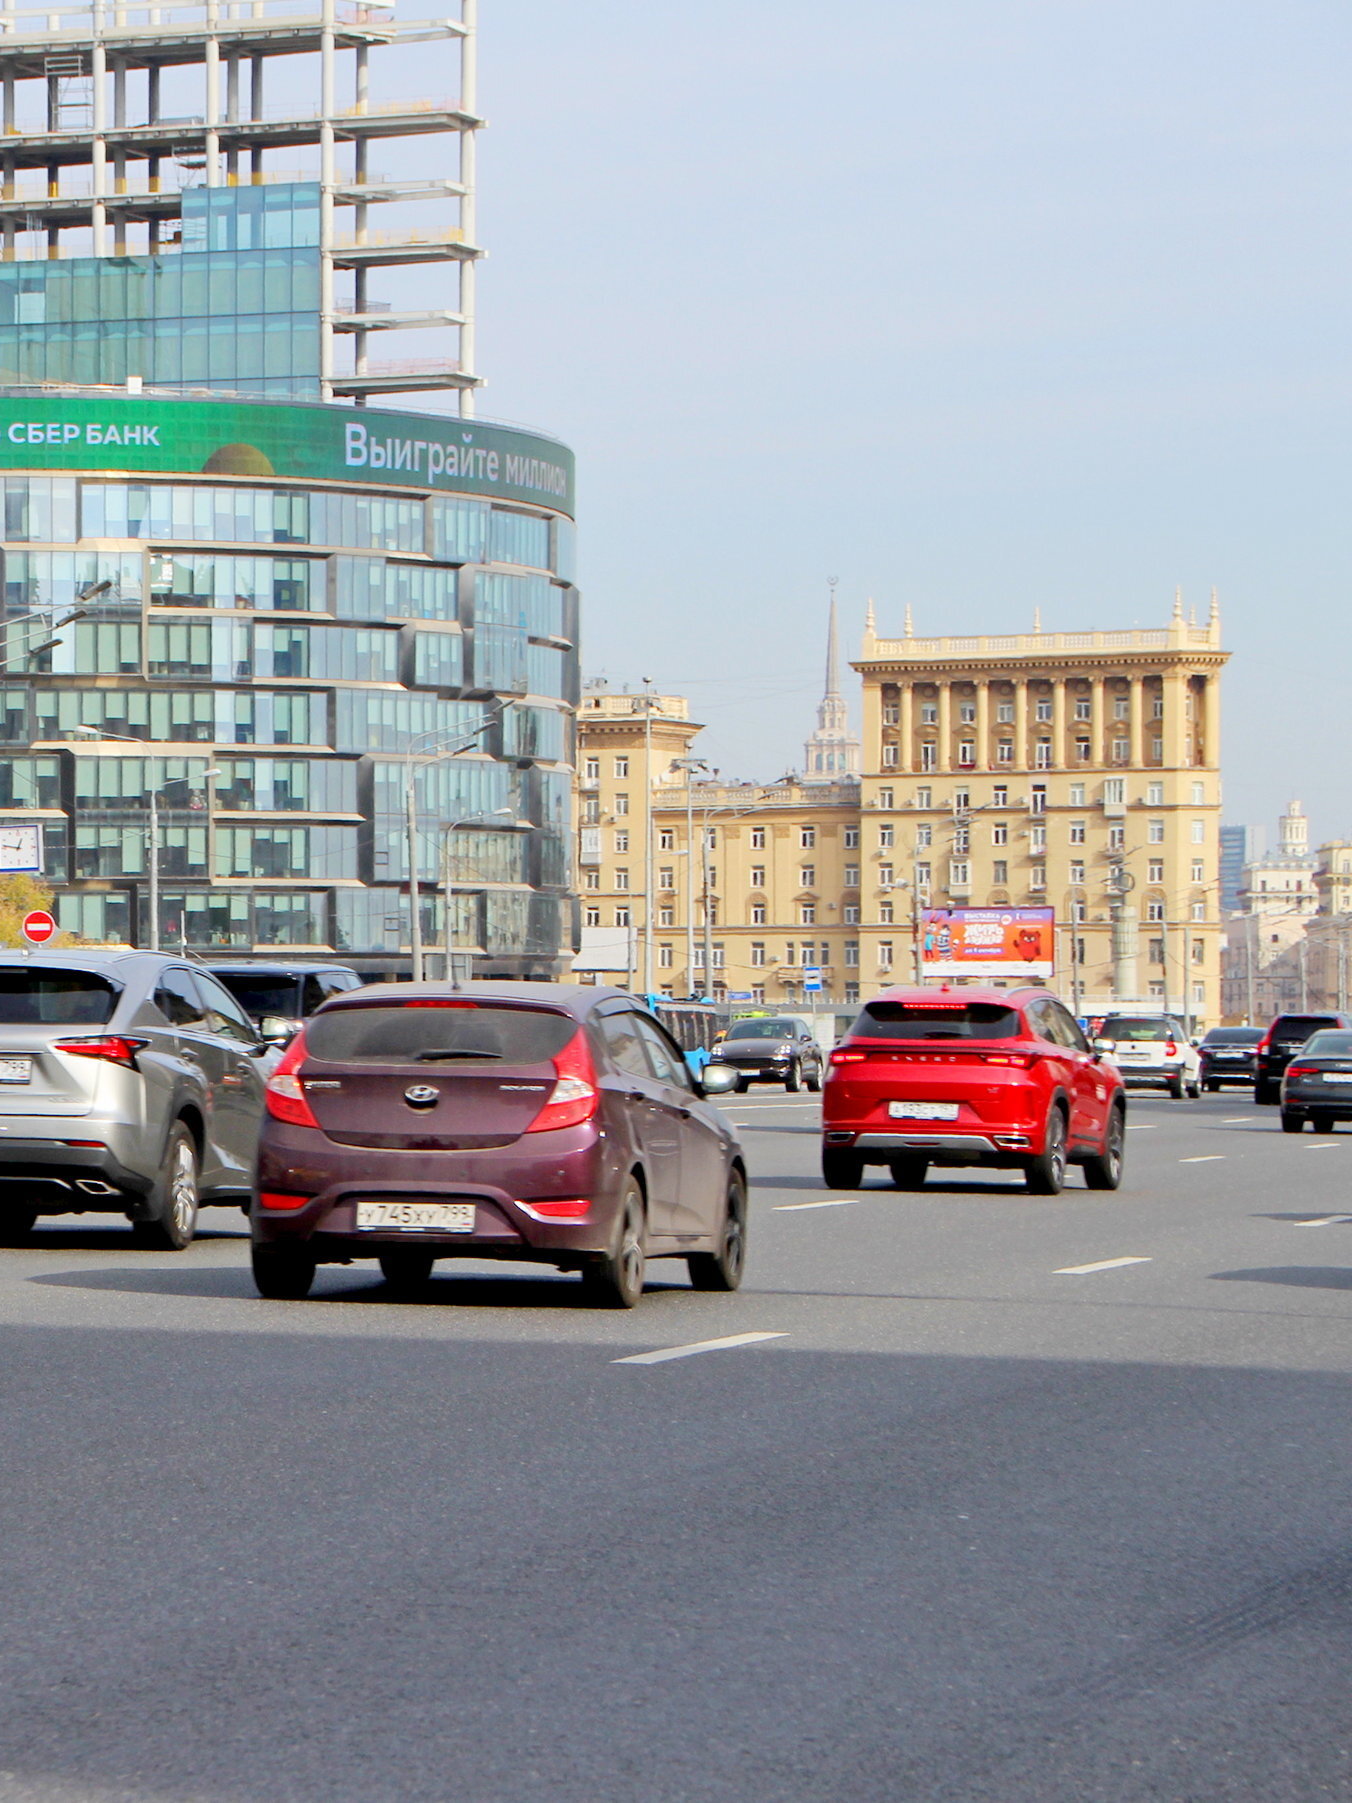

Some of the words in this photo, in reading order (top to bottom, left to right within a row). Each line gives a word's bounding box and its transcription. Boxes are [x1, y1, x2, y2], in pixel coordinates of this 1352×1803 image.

[8, 422, 80, 444] СБЕР
[86, 423, 160, 446] БАНК
[344, 422, 499, 485] Выиграйте
[505, 453, 567, 497] миллион
